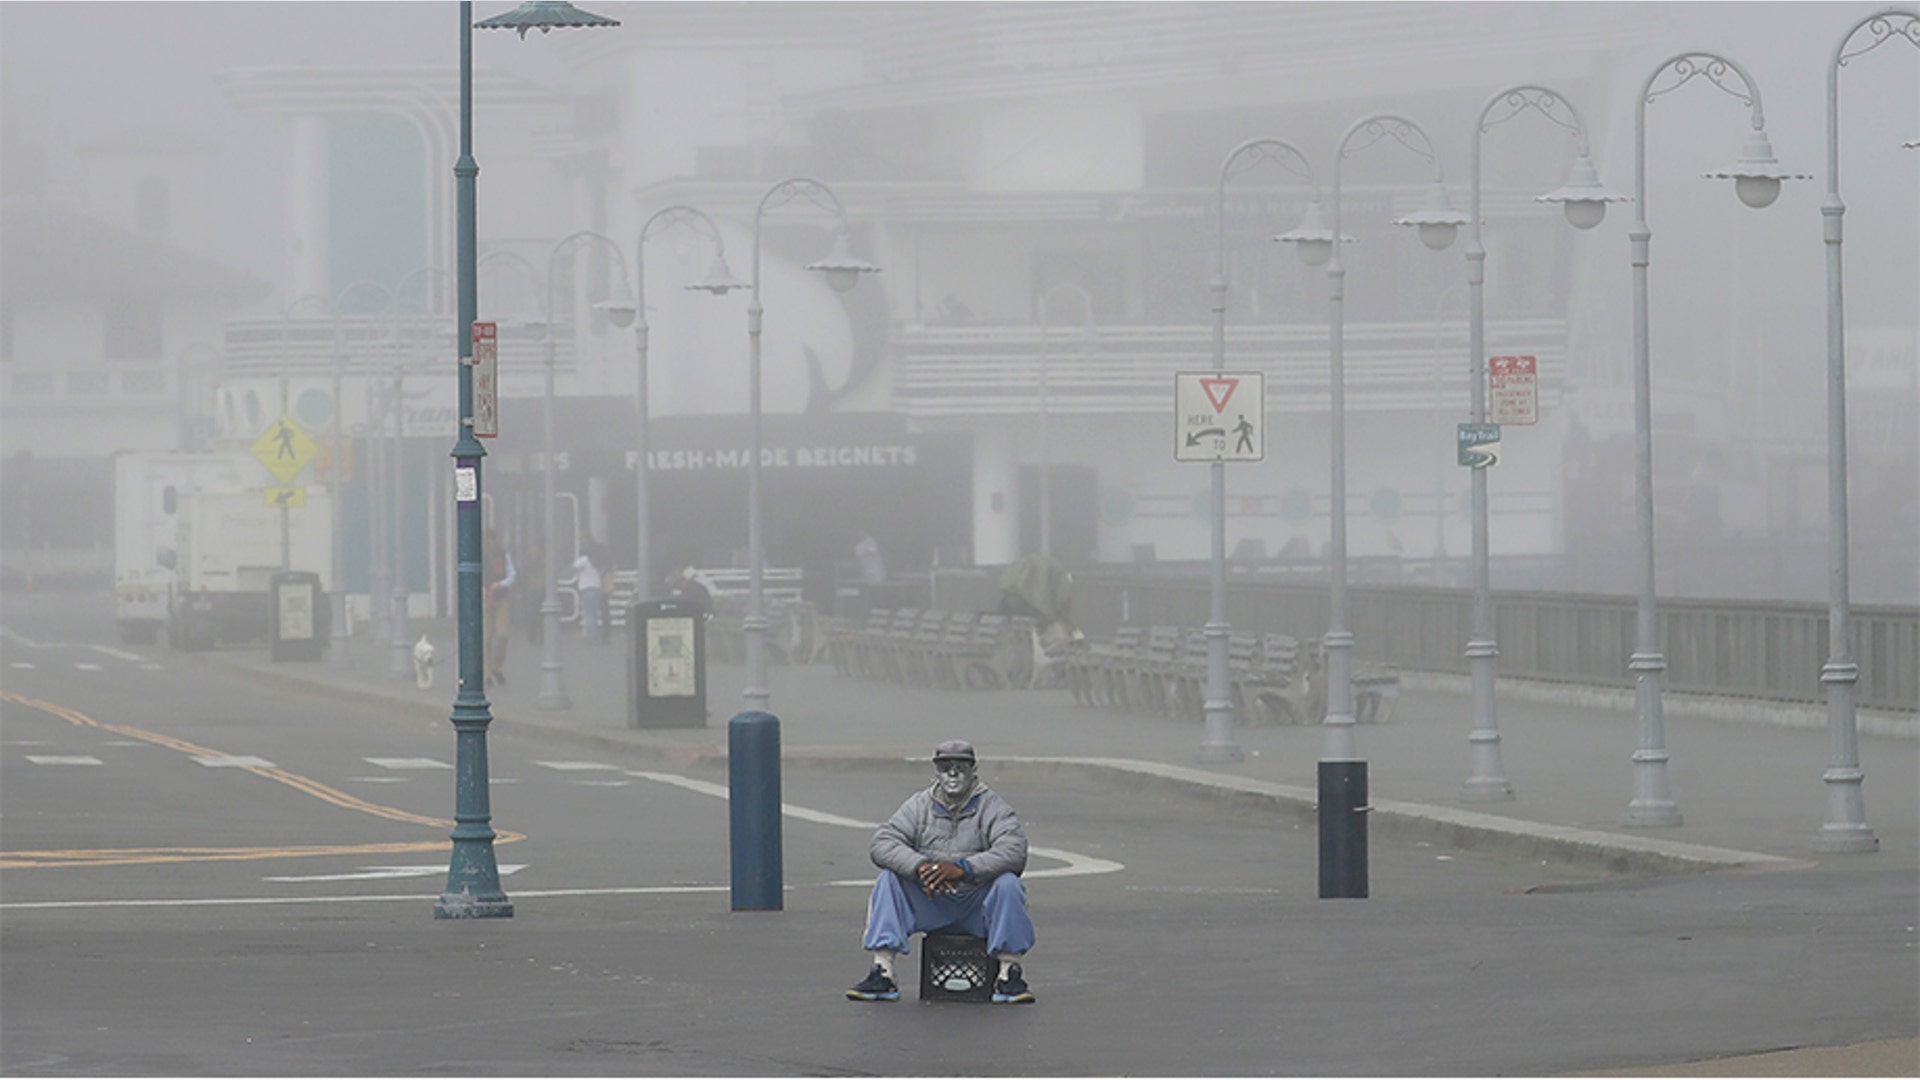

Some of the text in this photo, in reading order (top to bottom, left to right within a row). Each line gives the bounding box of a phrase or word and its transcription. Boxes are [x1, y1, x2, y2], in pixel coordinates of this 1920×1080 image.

[1188, 415, 1214, 425] HERE
[1213, 439, 1226, 450] TO
[796, 446, 917, 468] BEIGNETS
